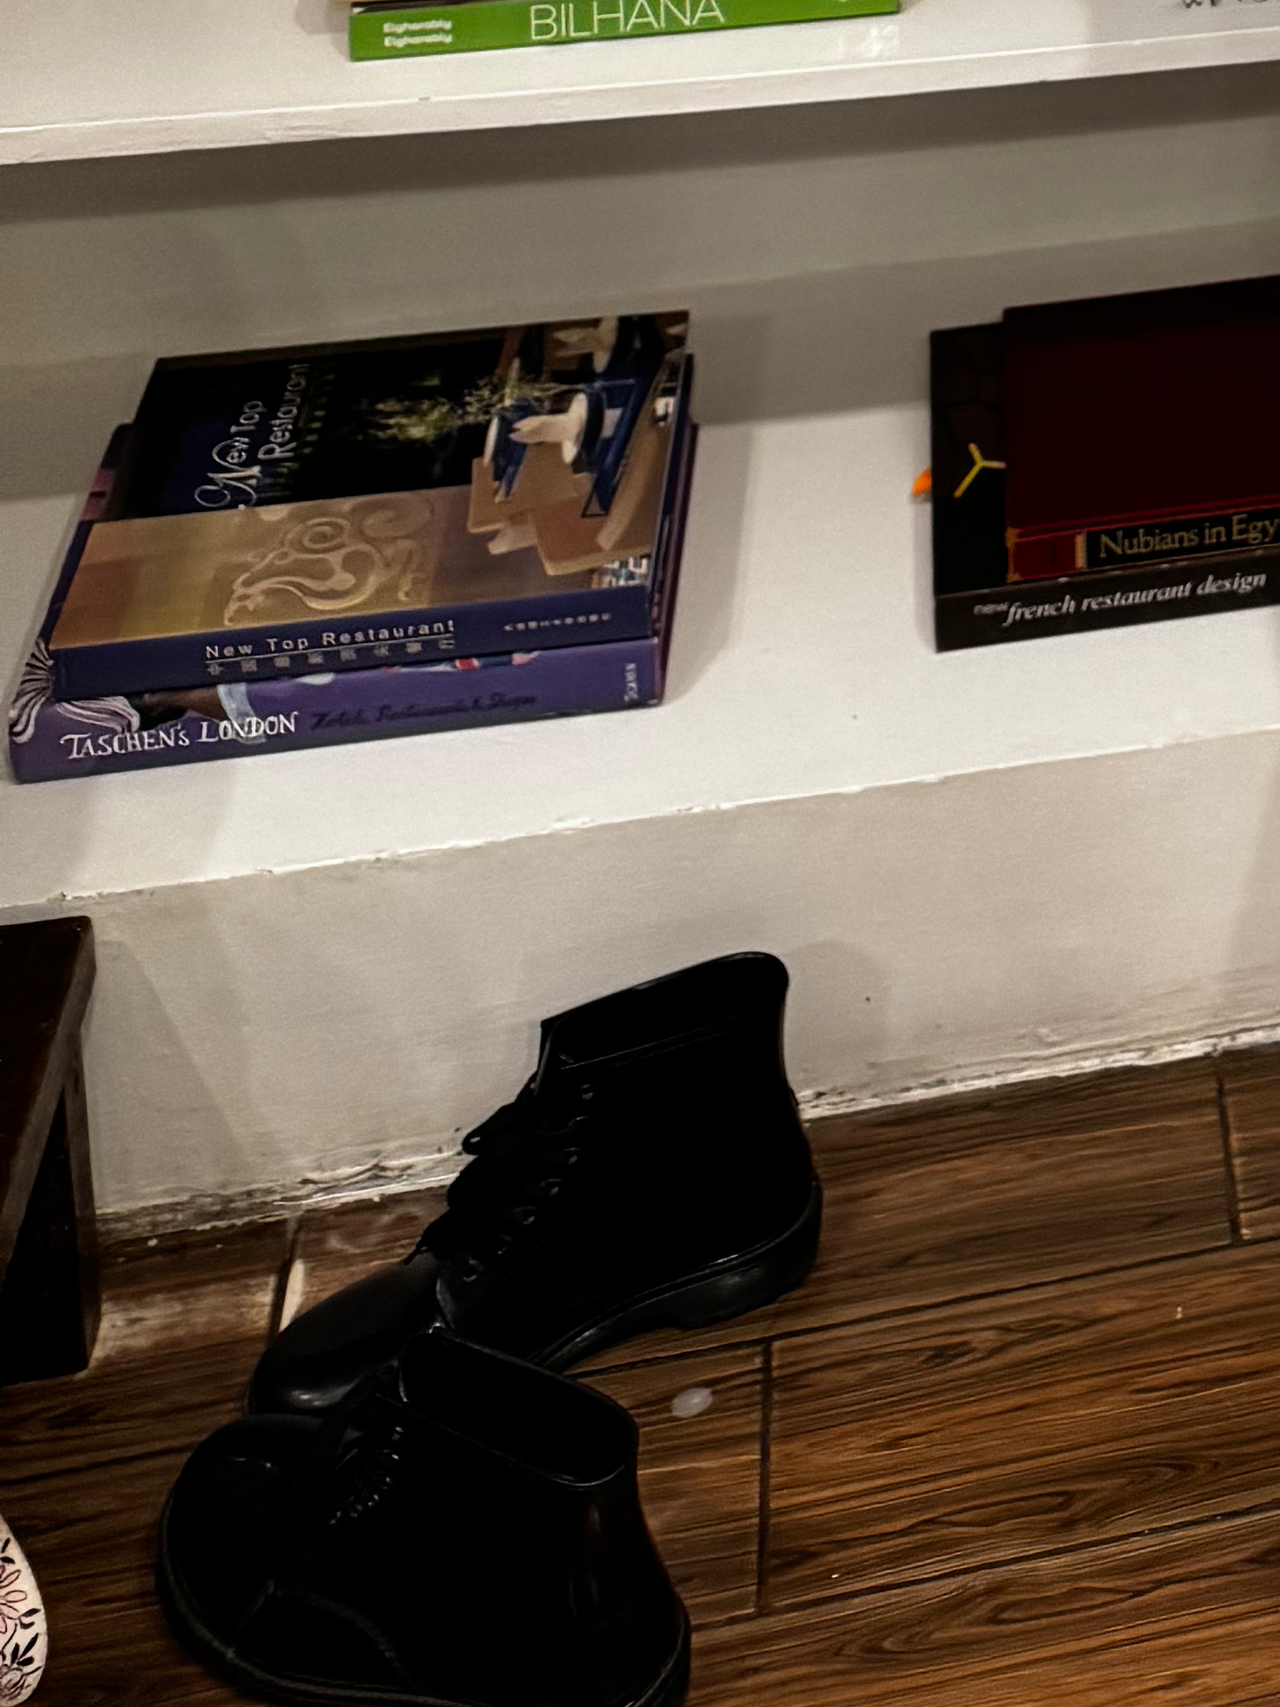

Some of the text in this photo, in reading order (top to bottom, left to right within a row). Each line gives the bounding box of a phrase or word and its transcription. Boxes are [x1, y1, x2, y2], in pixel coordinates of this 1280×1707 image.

[230, 400, 268, 434] Top
[257, 363, 310, 461] Restaurant
[1099, 529, 1199, 558] Nubians
[1203, 522, 1226, 545] in
[1001, 594, 1076, 629] french
[1080, 582, 1192, 612] restaurant
[1195, 573, 1268, 596] design
[205, 620, 455, 660] New Top Restaurant
[196, 711, 299, 743] LONDON
